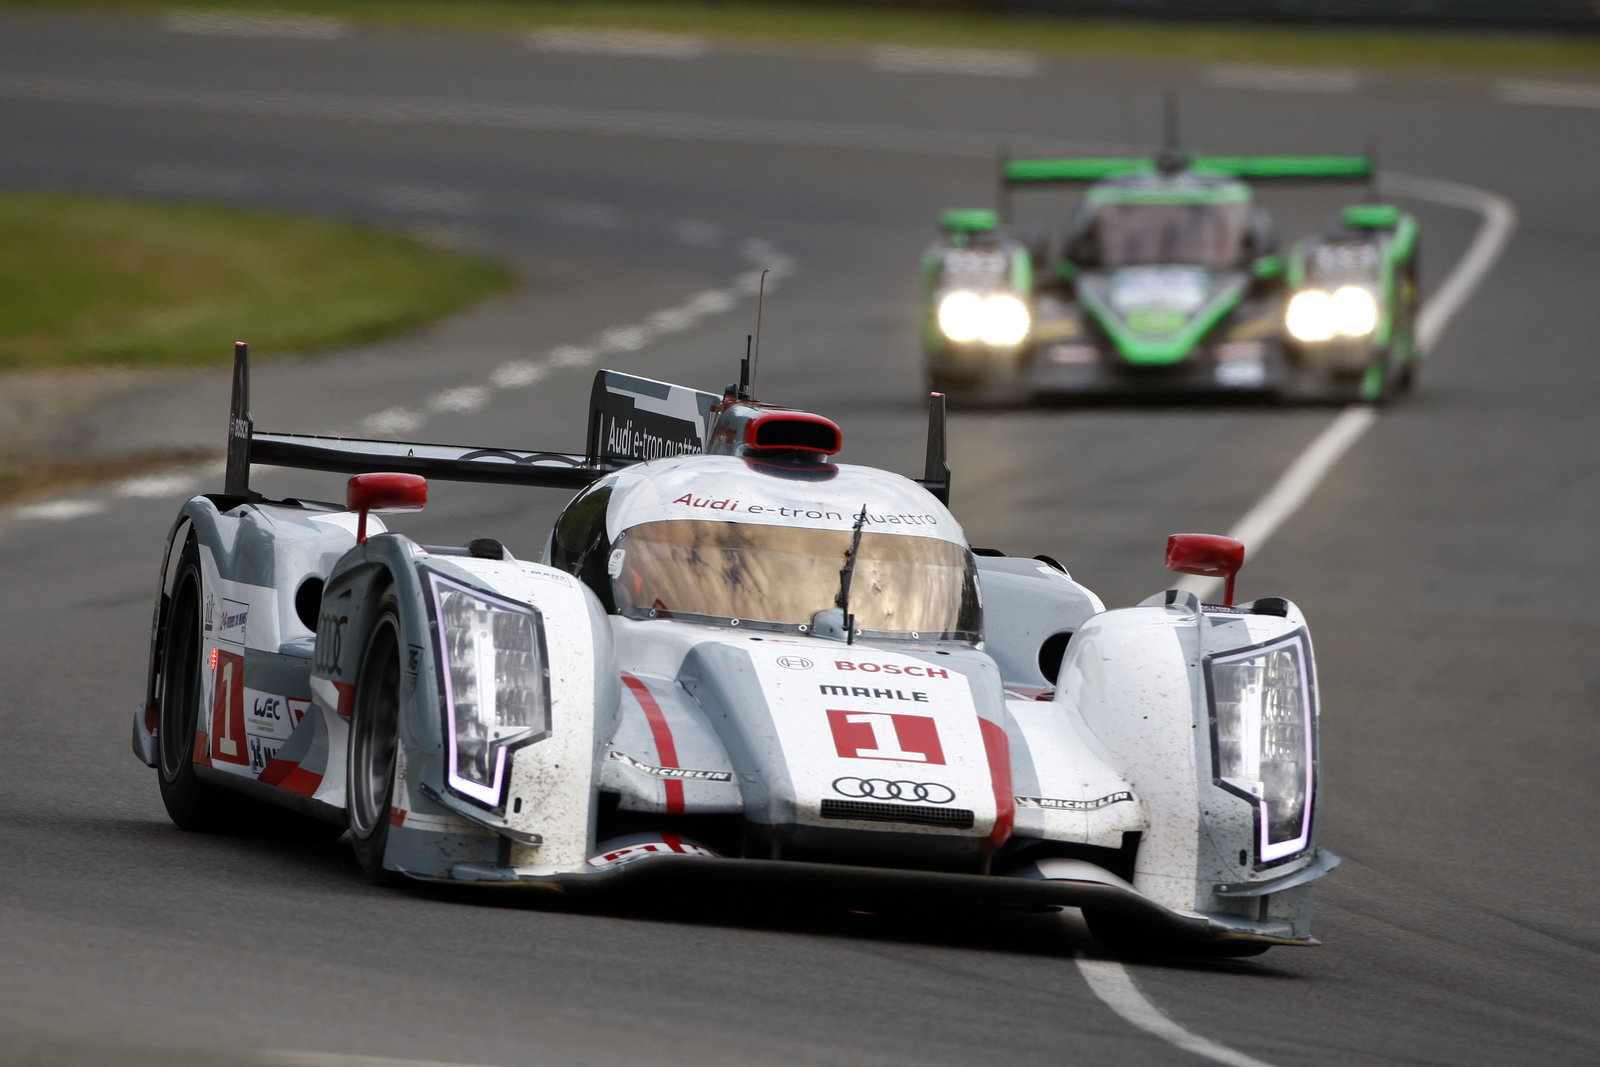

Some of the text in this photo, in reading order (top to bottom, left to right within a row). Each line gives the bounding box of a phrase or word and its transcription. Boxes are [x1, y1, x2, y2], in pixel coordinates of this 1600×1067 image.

[607, 416, 633, 456] Audi
[633, 427, 663, 460] e-tron
[672, 492, 937, 526] Audi e-tron quattro
[834, 660, 949, 679] BOSCH
[819, 684, 929, 703] MAHLE
[219, 661, 238, 756] 1
[254, 697, 281, 720] WEC
[845, 713, 928, 762] 1
[634, 762, 729, 780] MICHELIN
[1040, 791, 1128, 808] MICHELIN
